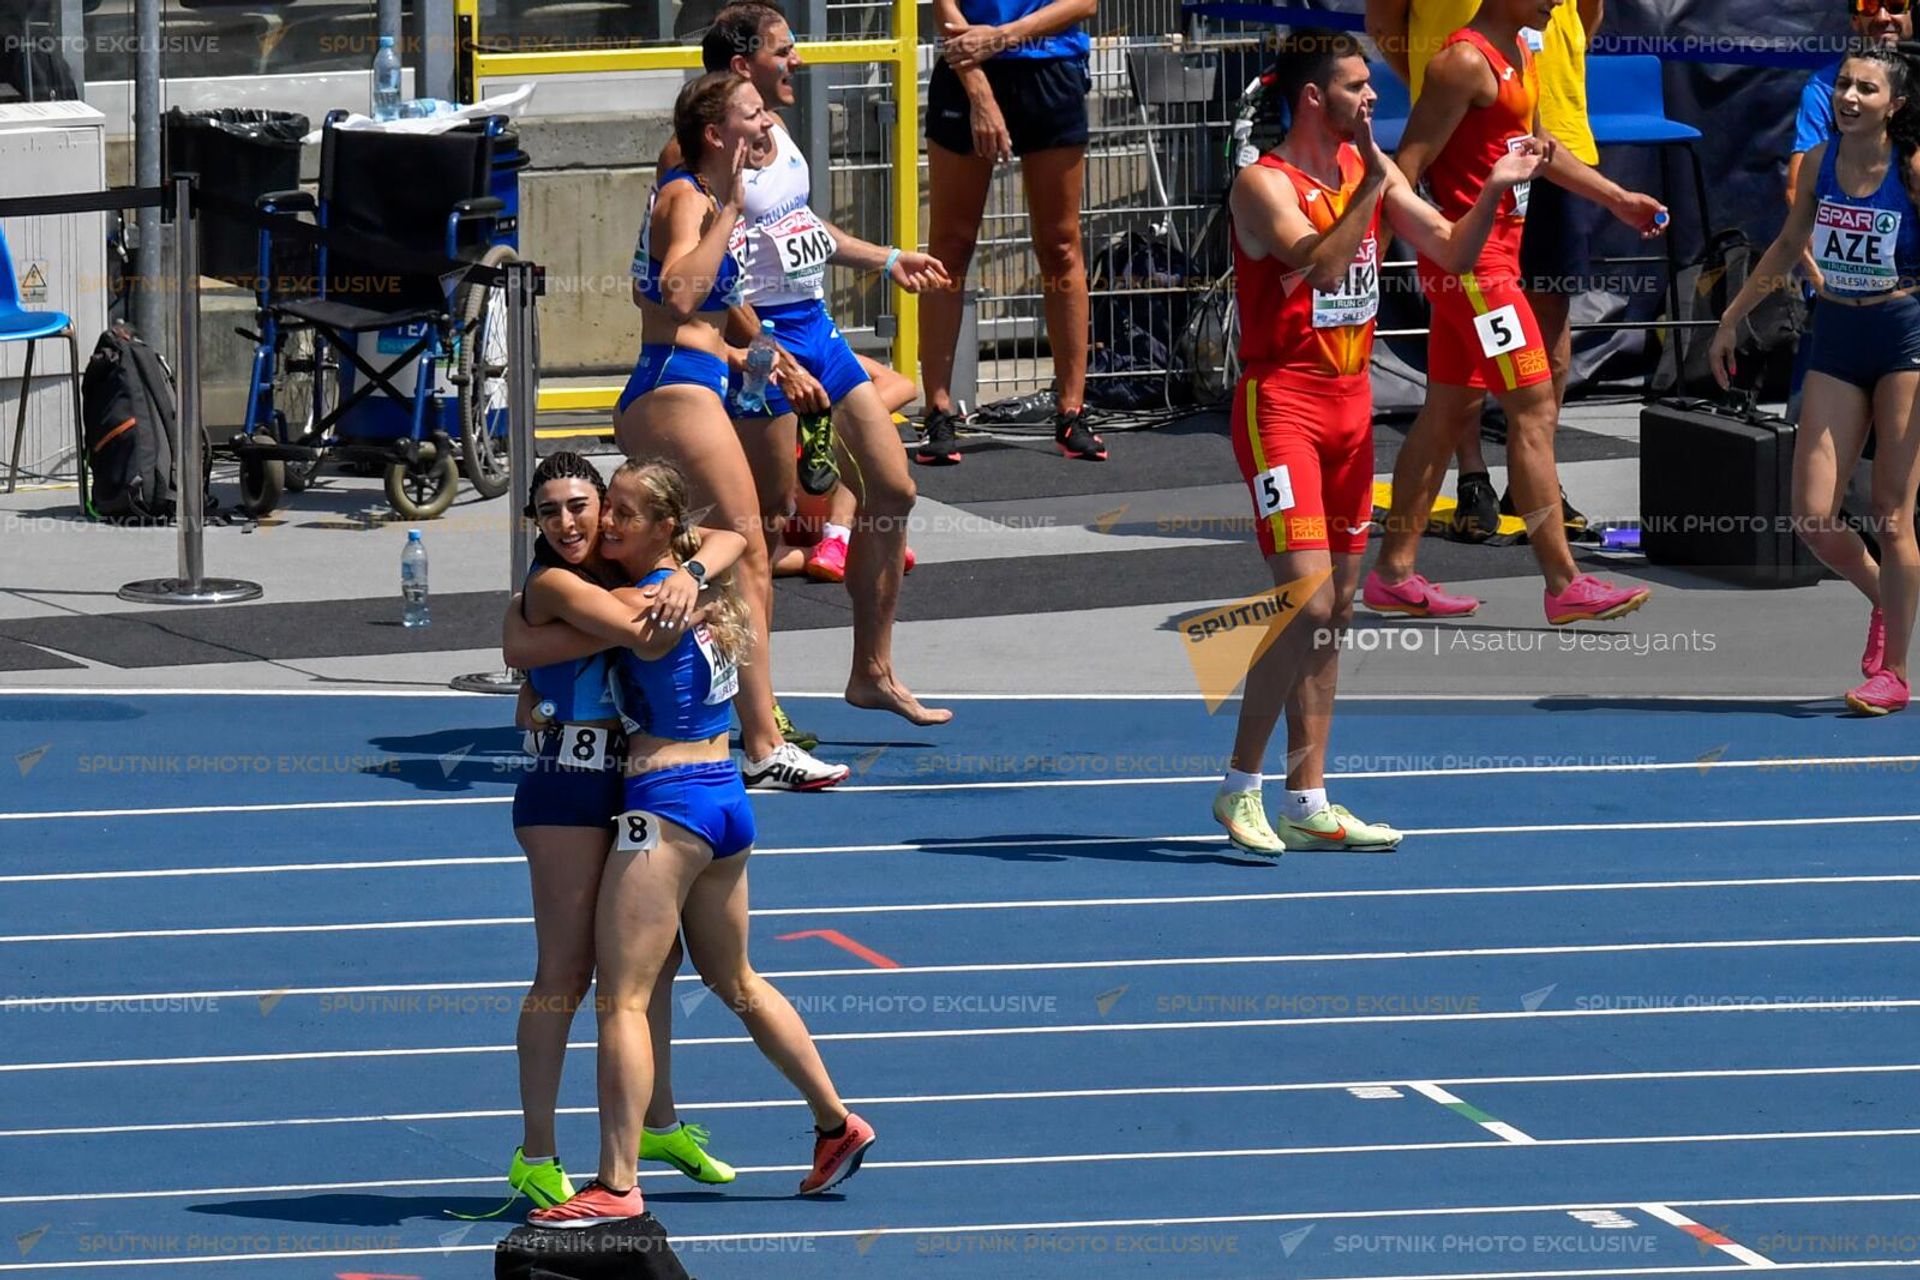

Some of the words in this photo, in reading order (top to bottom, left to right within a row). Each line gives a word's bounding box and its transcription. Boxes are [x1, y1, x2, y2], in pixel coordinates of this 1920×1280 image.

[1819, 206, 1872, 229] SPAR
[1823, 230, 1883, 265] AZE
[1848, 264, 1875, 275] CLEAN
[1490, 316, 1512, 347] 5
[1263, 476, 1280, 508] 5
[572, 729, 596, 761] 8
[767, 763, 808, 785] AIR
[627, 815, 647, 843] 8
